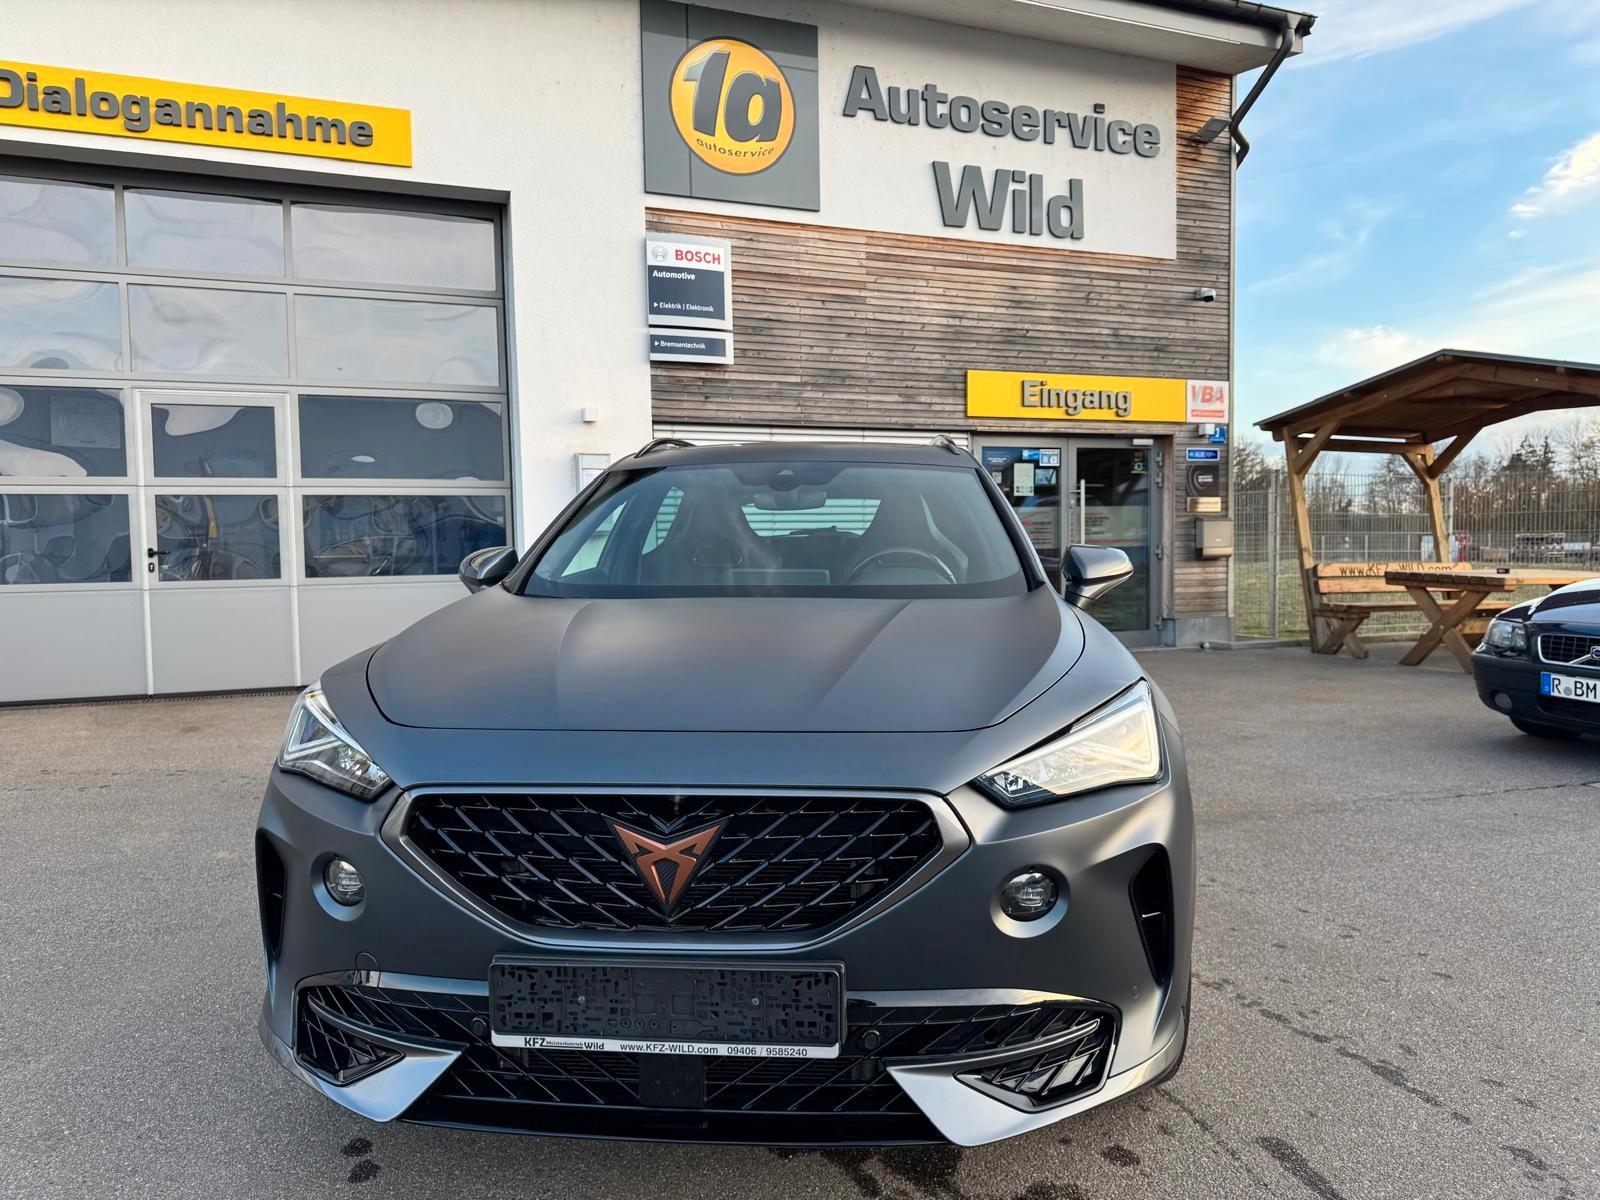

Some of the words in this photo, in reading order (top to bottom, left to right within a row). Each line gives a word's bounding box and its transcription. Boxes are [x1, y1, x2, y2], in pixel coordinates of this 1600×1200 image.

[683, 50, 782, 143] 1a
[0, 68, 373, 147] Dialogannahme
[843, 65, 1161, 158] Autoservice
[696, 138, 774, 157] autoservice
[932, 160, 1084, 239] Wild
[675, 249, 721, 265] BOSCH
[652, 270, 695, 280] Automotive
[659, 302, 682, 310] Elektrik
[686, 303, 714, 313] Elektronik
[660, 340, 706, 350] Bremsentechnik
[1021, 379, 1132, 417] Eingang
[1191, 384, 1224, 405] VBA
[1551, 677, 1562, 695] R
[1573, 680, 1598, 700] BM
[524, 1037, 546, 1047] KFZ
[584, 1041, 605, 1050] Wild
[620, 1043, 718, 1054] www.KFZ-WILD.com
[727, 1045, 757, 1056] 09406
[766, 1047, 808, 1057] 9585240
